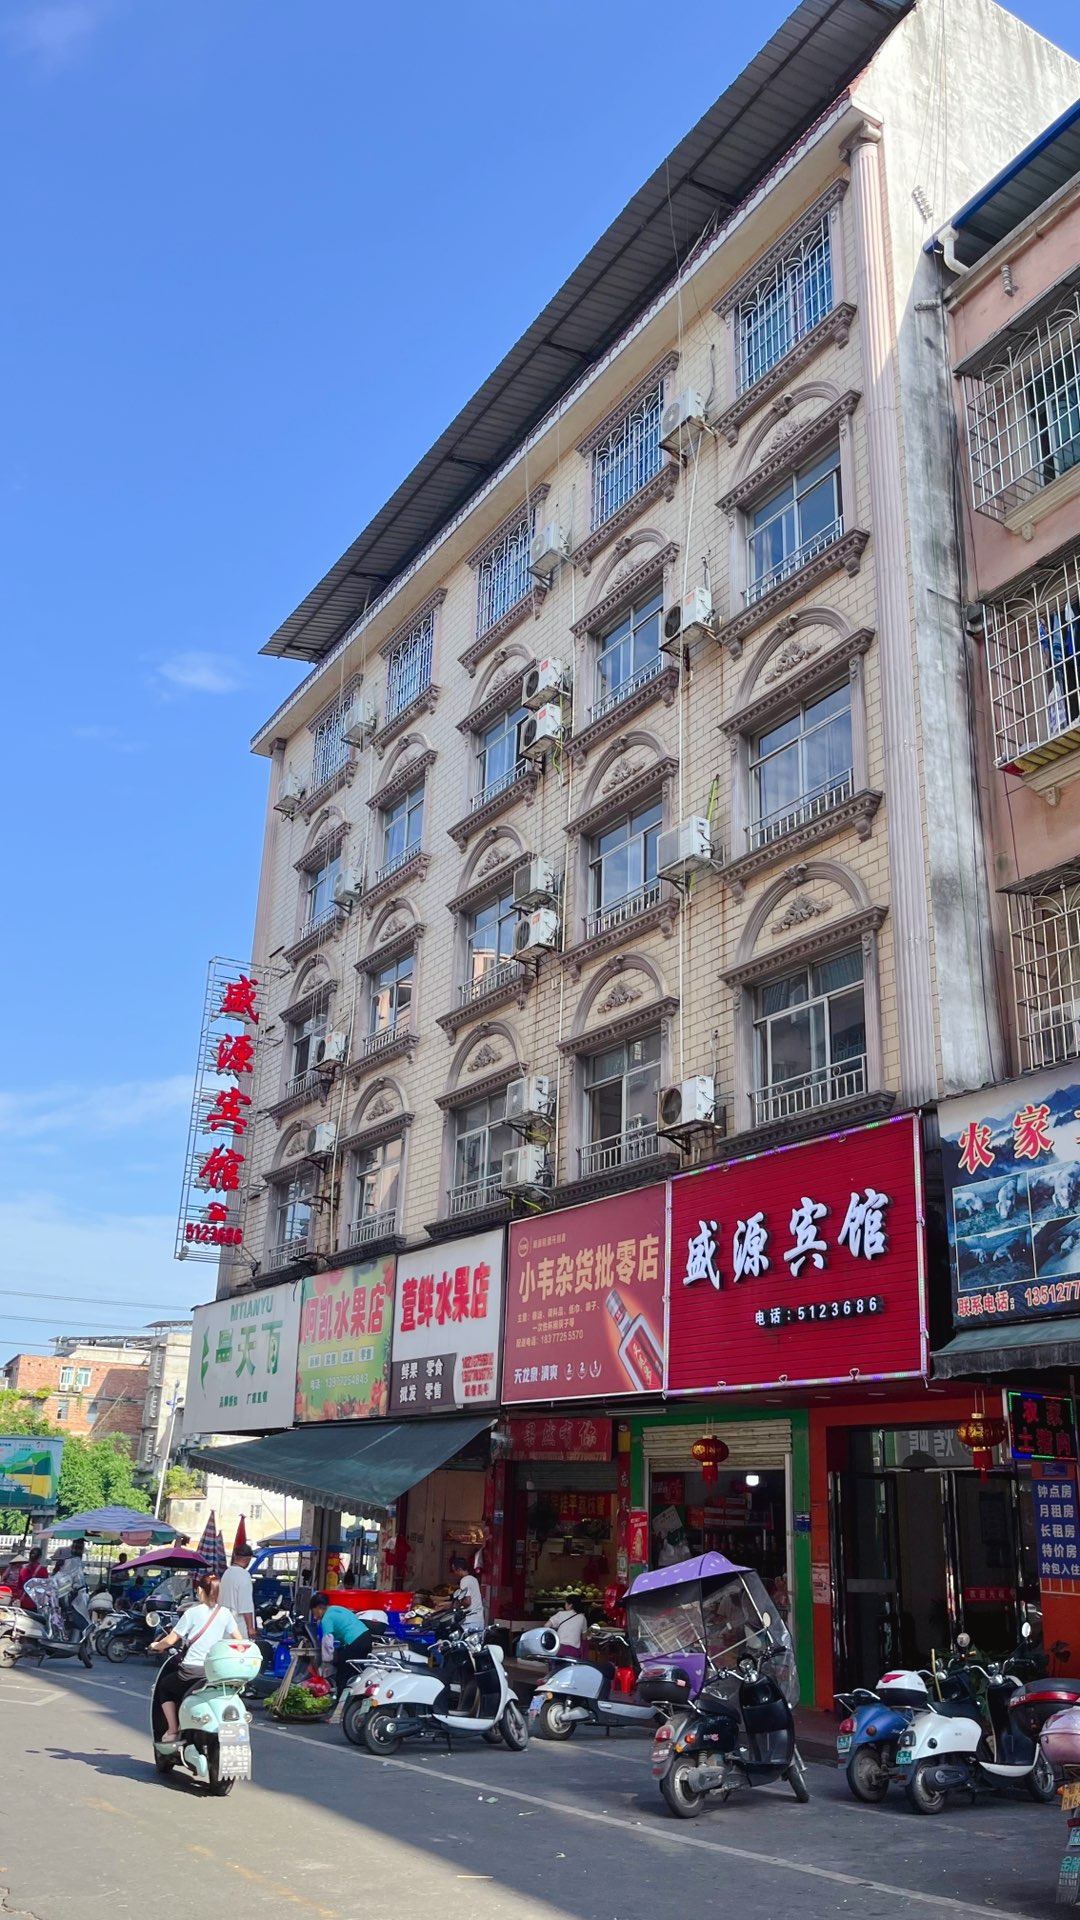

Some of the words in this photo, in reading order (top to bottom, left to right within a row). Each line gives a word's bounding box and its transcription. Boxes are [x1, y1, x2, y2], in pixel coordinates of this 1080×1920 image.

[199, 974, 259, 1191] 盛源宾馆
[957, 1104, 1080, 1175] 农家
[185, 1223, 243, 1246] 5123686
[682, 1188, 892, 1290] 盛源宾馆
[518, 1233, 660, 1303] 小韦杂货批零店
[303, 1281, 387, 1345] 阿凯水果店
[401, 1362, 419, 1380] 鲜果
[426, 1358, 445, 1377] 零食
[399, 1384, 417, 1403] 批发
[425, 1381, 443, 1401] 零售
[1037, 1484, 1072, 1499] 钟点房
[1040, 1504, 1075, 1519] 月租房
[1041, 1524, 1076, 1539] 长租房
[1042, 1543, 1078, 1559] 特价房
